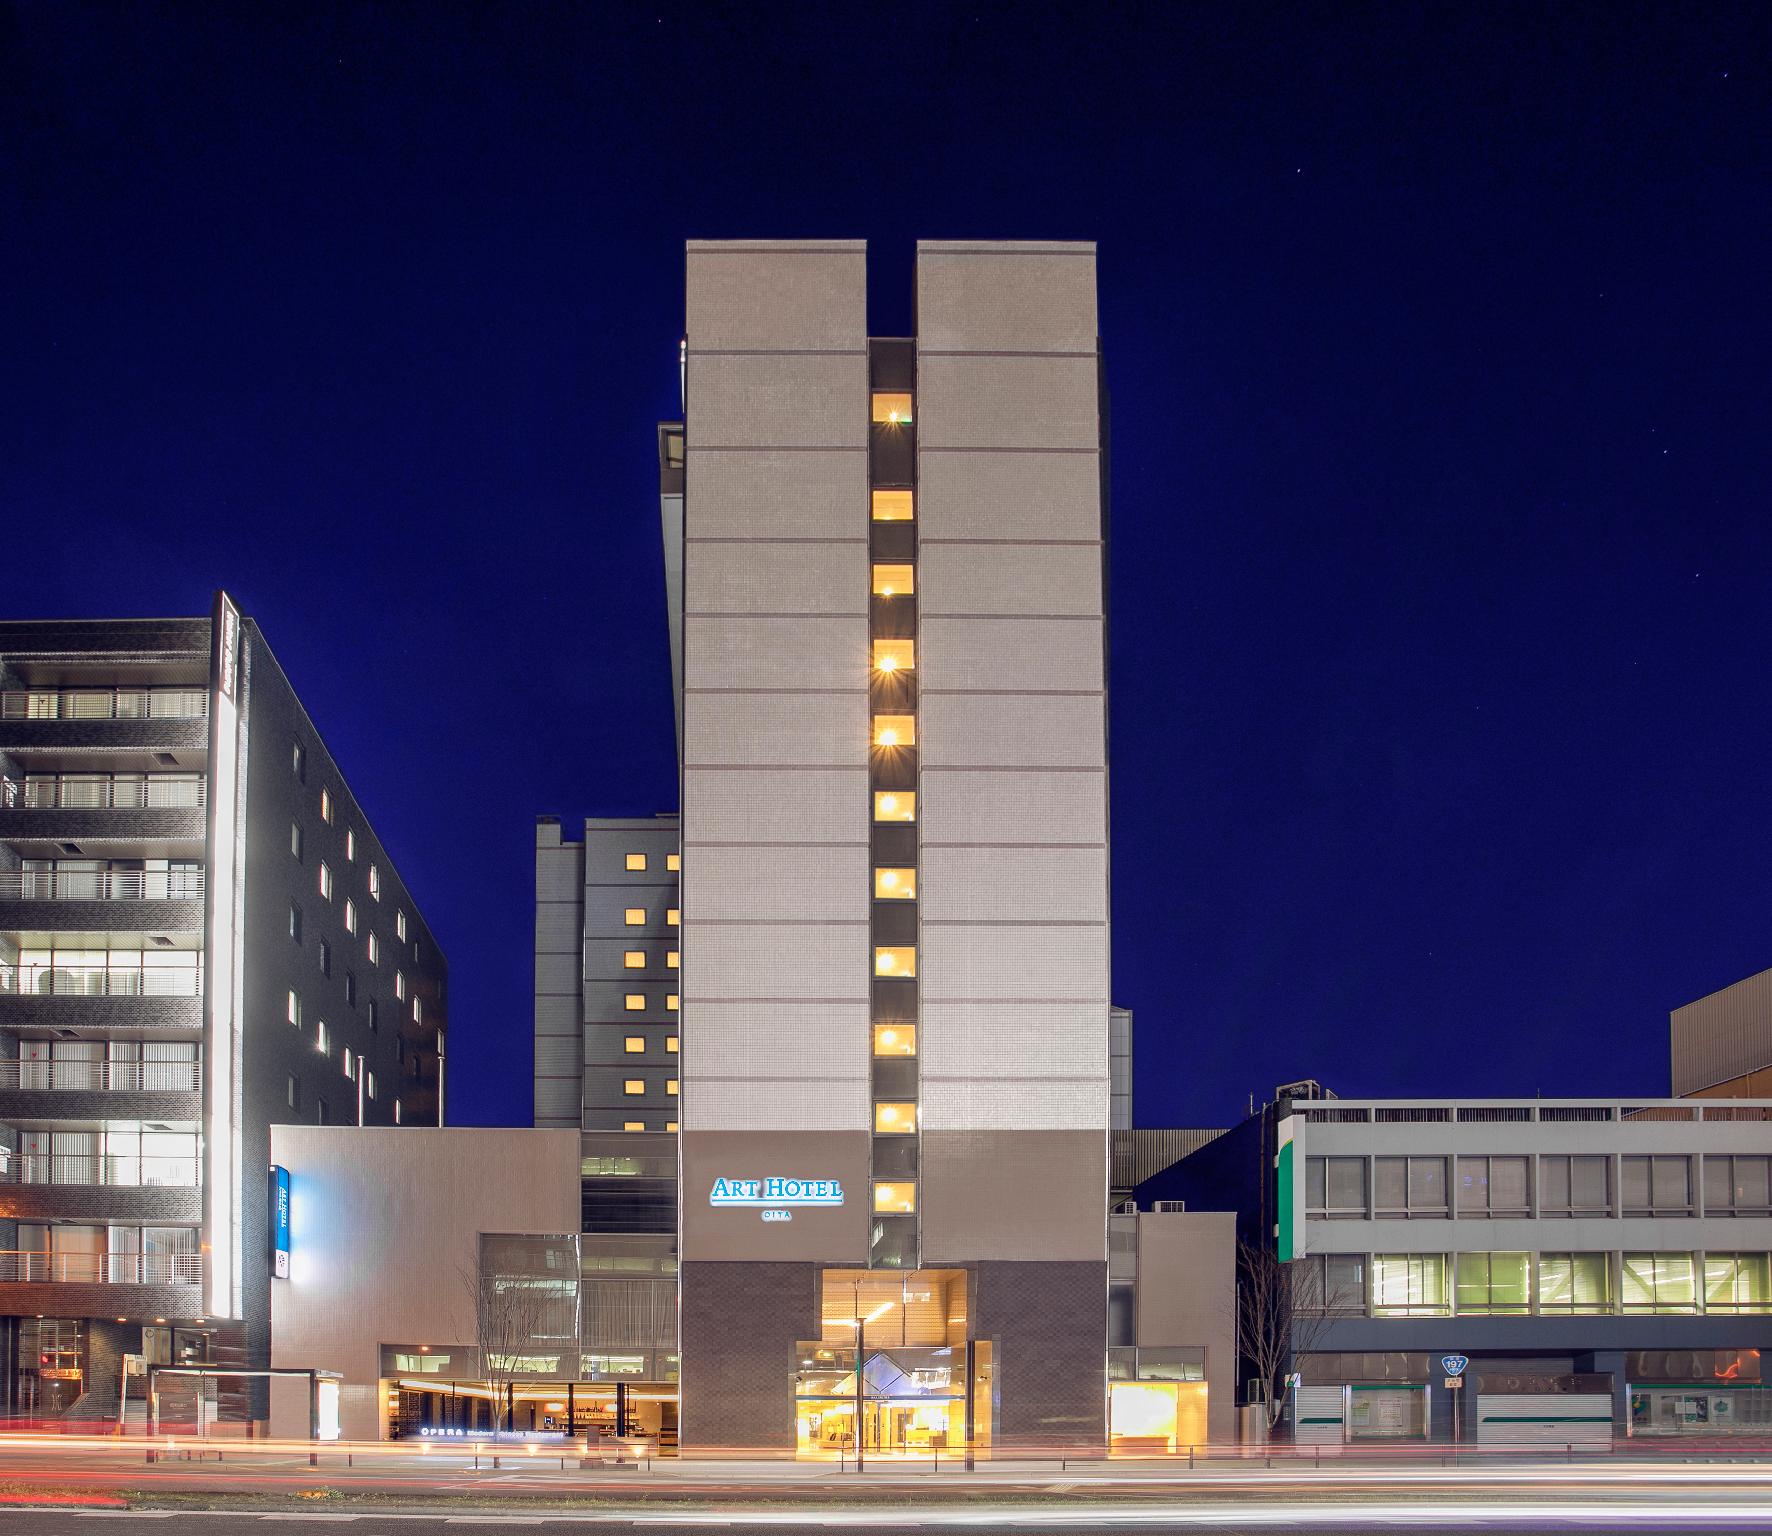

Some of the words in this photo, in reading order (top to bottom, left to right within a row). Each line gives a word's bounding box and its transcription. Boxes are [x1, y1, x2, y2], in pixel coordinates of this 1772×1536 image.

[711, 1178, 758, 1197] ART
[766, 1178, 843, 1197] HOTEL
[763, 1211, 791, 1219] OITA
[1446, 1360, 1463, 1368] 197
[421, 1427, 463, 1436] OPERA
